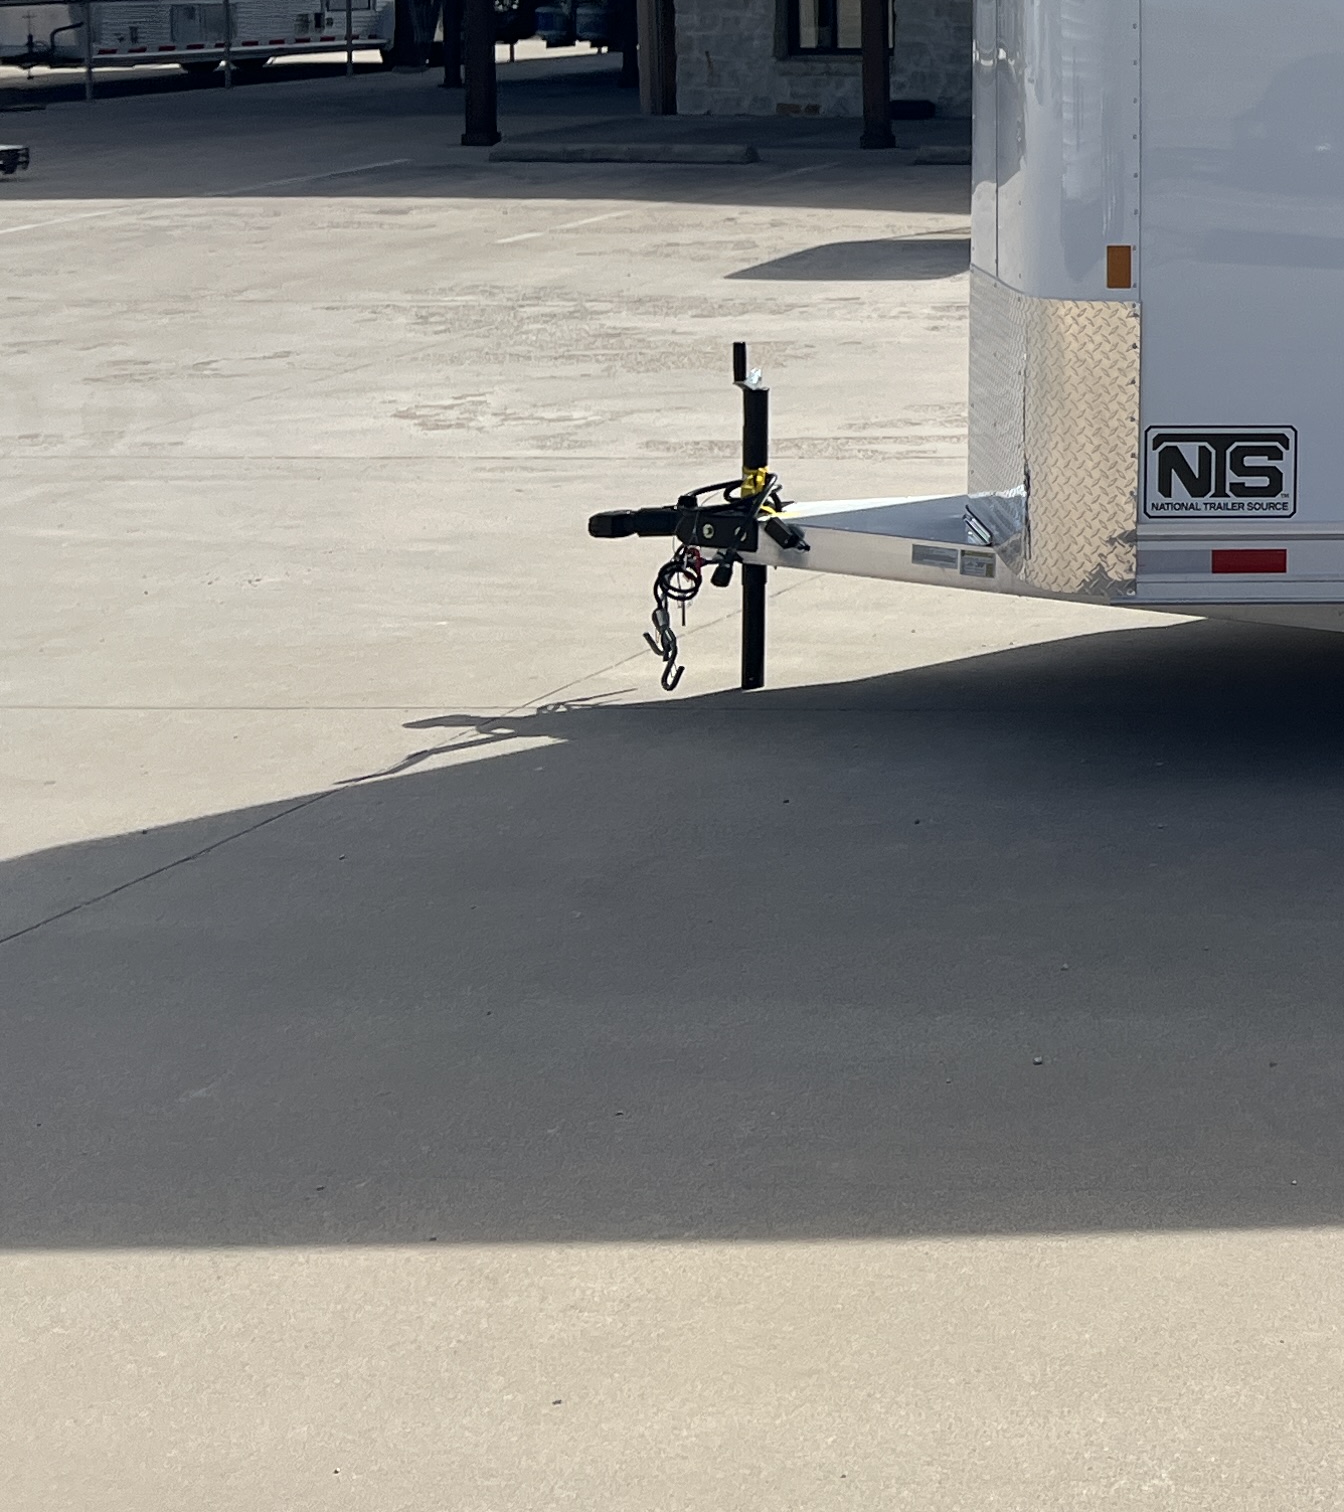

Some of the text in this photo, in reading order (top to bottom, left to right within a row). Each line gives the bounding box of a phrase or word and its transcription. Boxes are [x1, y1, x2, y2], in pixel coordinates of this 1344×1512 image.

[1152, 433, 1290, 498] NTS
[1151, 501, 1289, 512] NATIONAL TRAILER SOURCE
